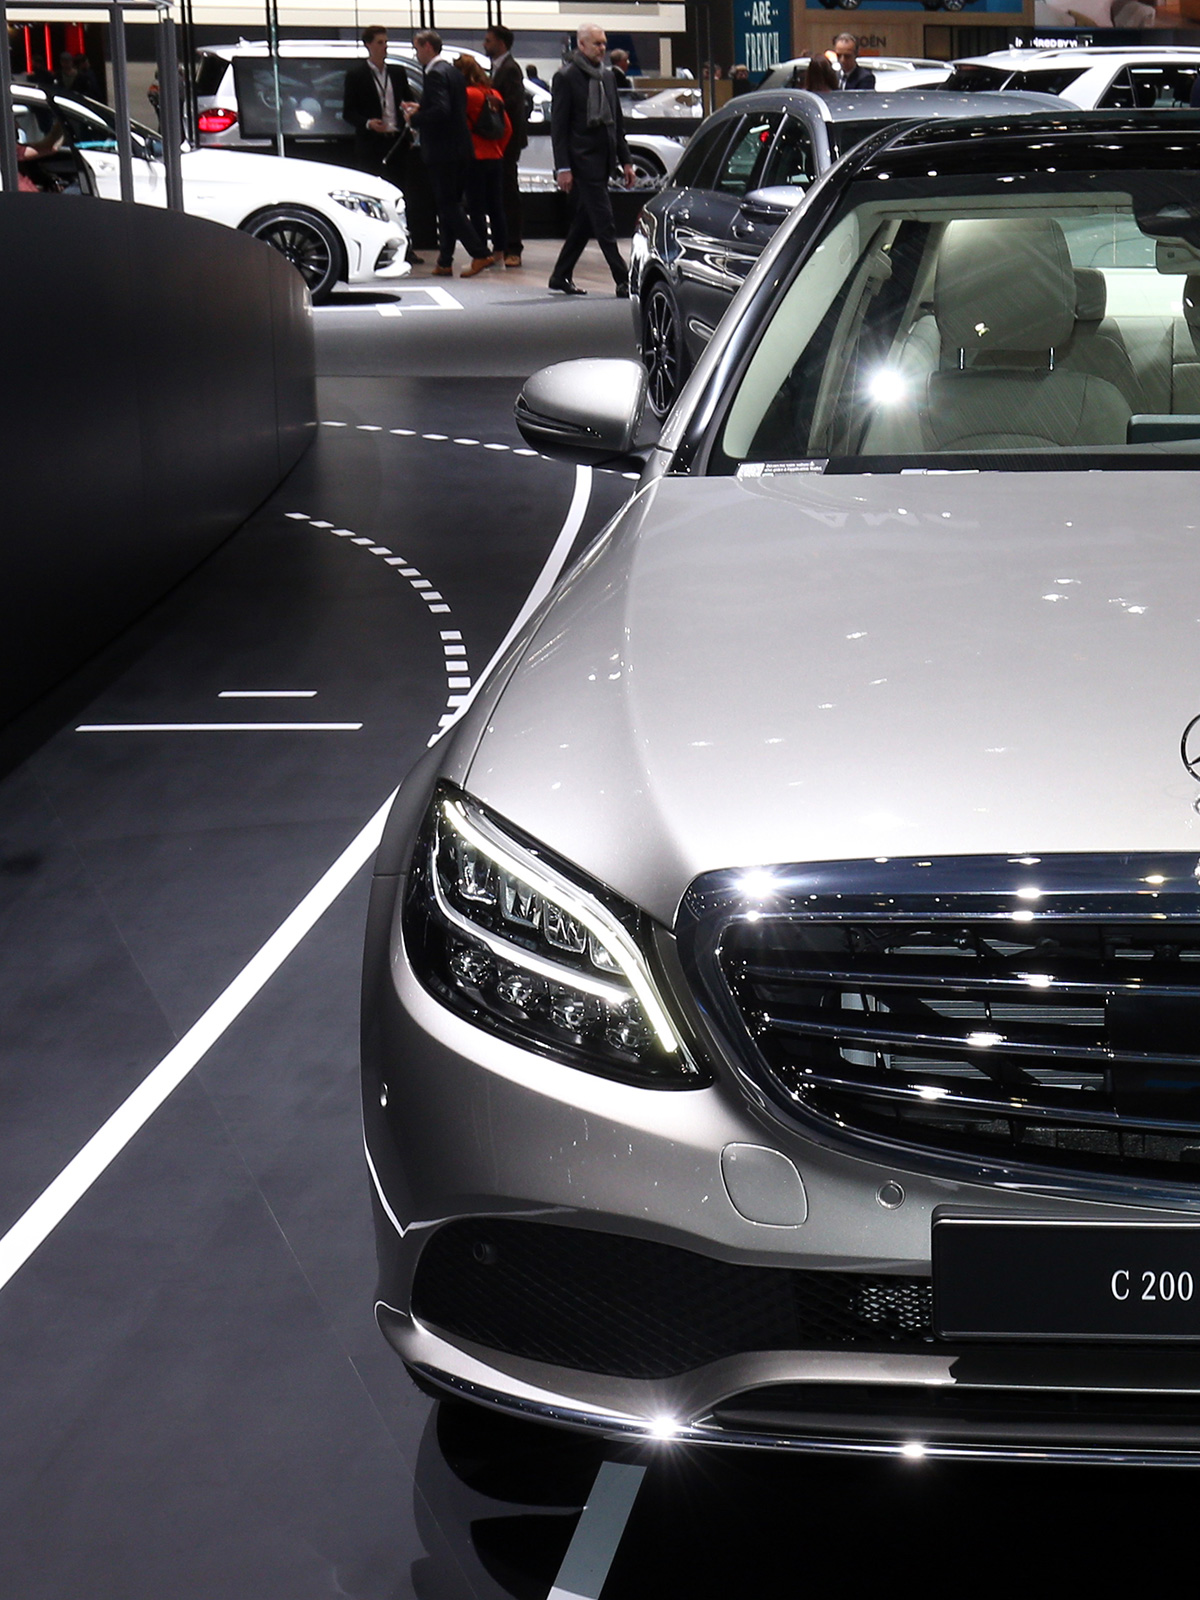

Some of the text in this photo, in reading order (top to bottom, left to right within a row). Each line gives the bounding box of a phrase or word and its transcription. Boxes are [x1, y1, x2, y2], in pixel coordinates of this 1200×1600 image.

[751, 1, 772, 26] ARE
[744, 31, 780, 72] FRENCH
[1110, 1269, 1130, 1301] C
[1140, 1270, 1194, 1301] 200
